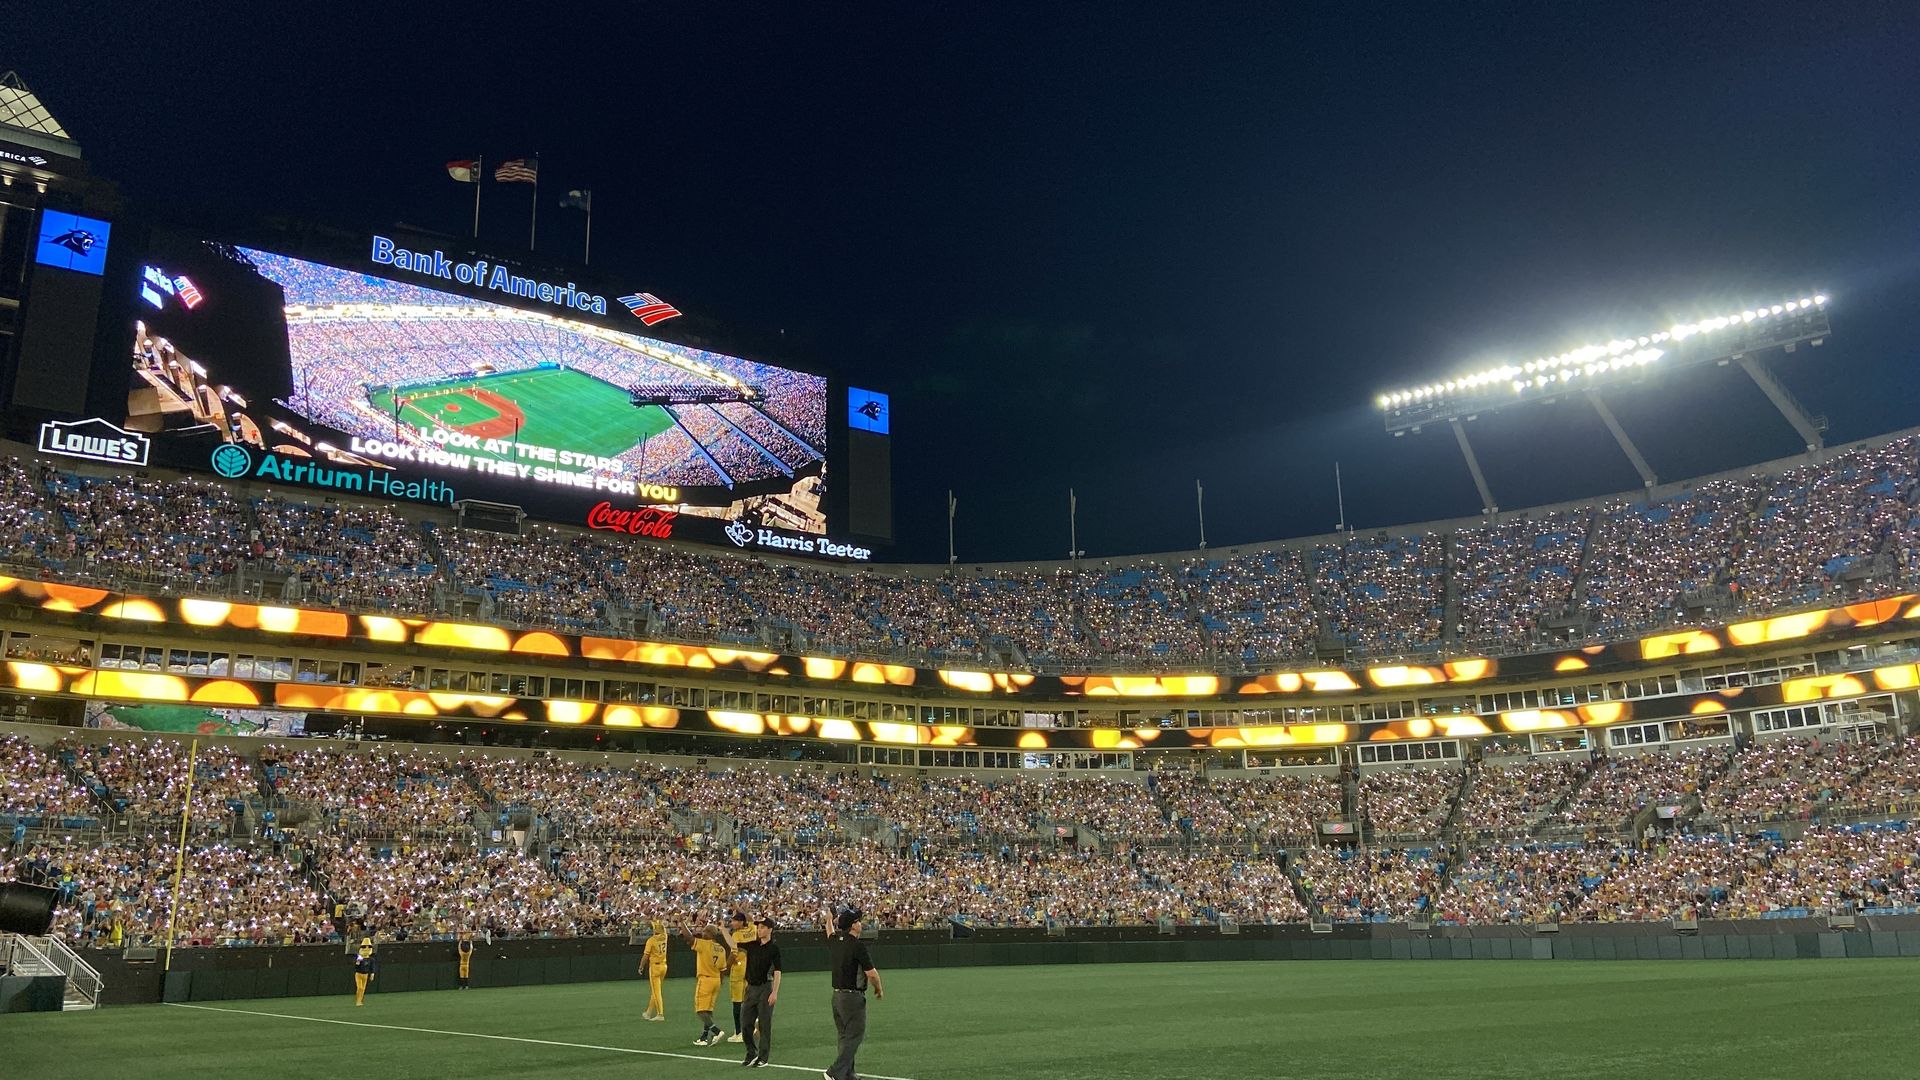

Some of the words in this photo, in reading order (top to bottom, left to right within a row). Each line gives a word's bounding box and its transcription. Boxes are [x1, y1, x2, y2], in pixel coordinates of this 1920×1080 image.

[371, 235, 452, 280] Bank
[454, 260, 488, 287] of
[489, 265, 607, 315] America
[51, 428, 139, 461] LOWE'S
[420, 426, 480, 450] LOOK
[483, 439, 513, 455] AT
[515, 443, 558, 462] THE
[559, 450, 624, 473] STARS
[256, 454, 363, 492] Atrium
[368, 470, 455, 503] Health
[351, 437, 419, 461] LOOK
[419, 449, 472, 470] HOW
[473, 457, 531, 479] THEY
[533, 466, 595, 489] SHINE
[596, 478, 635, 495] FOR
[637, 482, 677, 501] YOU
[757, 528, 813, 552] Harris
[816, 537, 871, 561] Teeter
